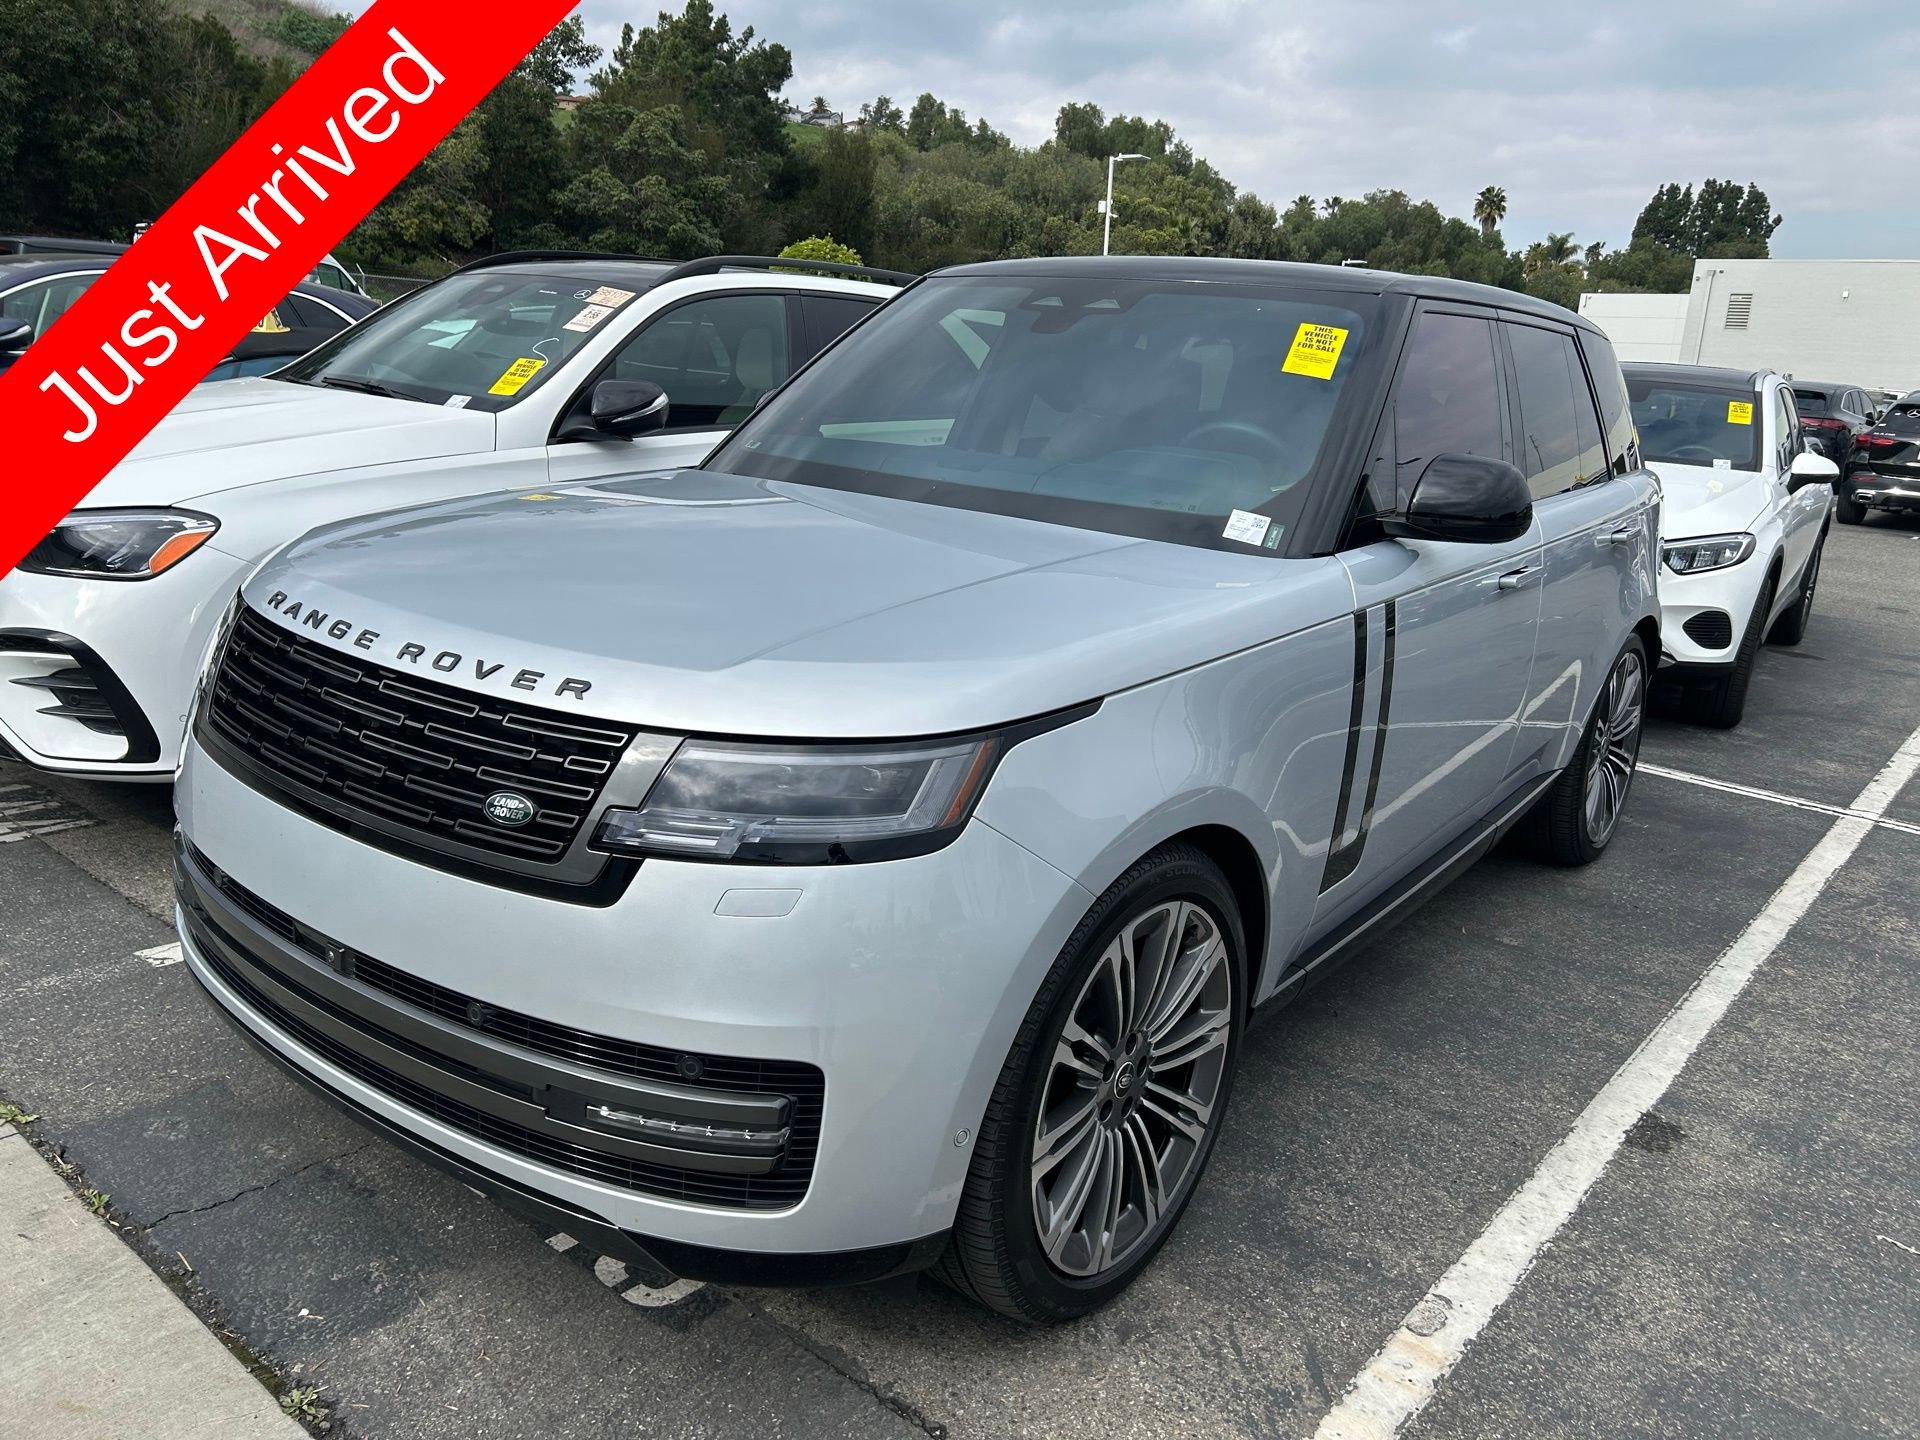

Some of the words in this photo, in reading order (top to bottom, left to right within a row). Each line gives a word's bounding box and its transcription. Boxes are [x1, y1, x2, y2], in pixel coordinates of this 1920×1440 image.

[1314, 326, 1333, 334] THIS
[1304, 331, 1338, 341] VEHICLE
[1315, 338, 1333, 346] NOT
[1315, 345, 1336, 353] SALE
[267, 590, 381, 650] RANGE
[396, 641, 593, 701] ROVER
[494, 797, 519, 809] LAND
[494, 806, 525, 819] ROVER
